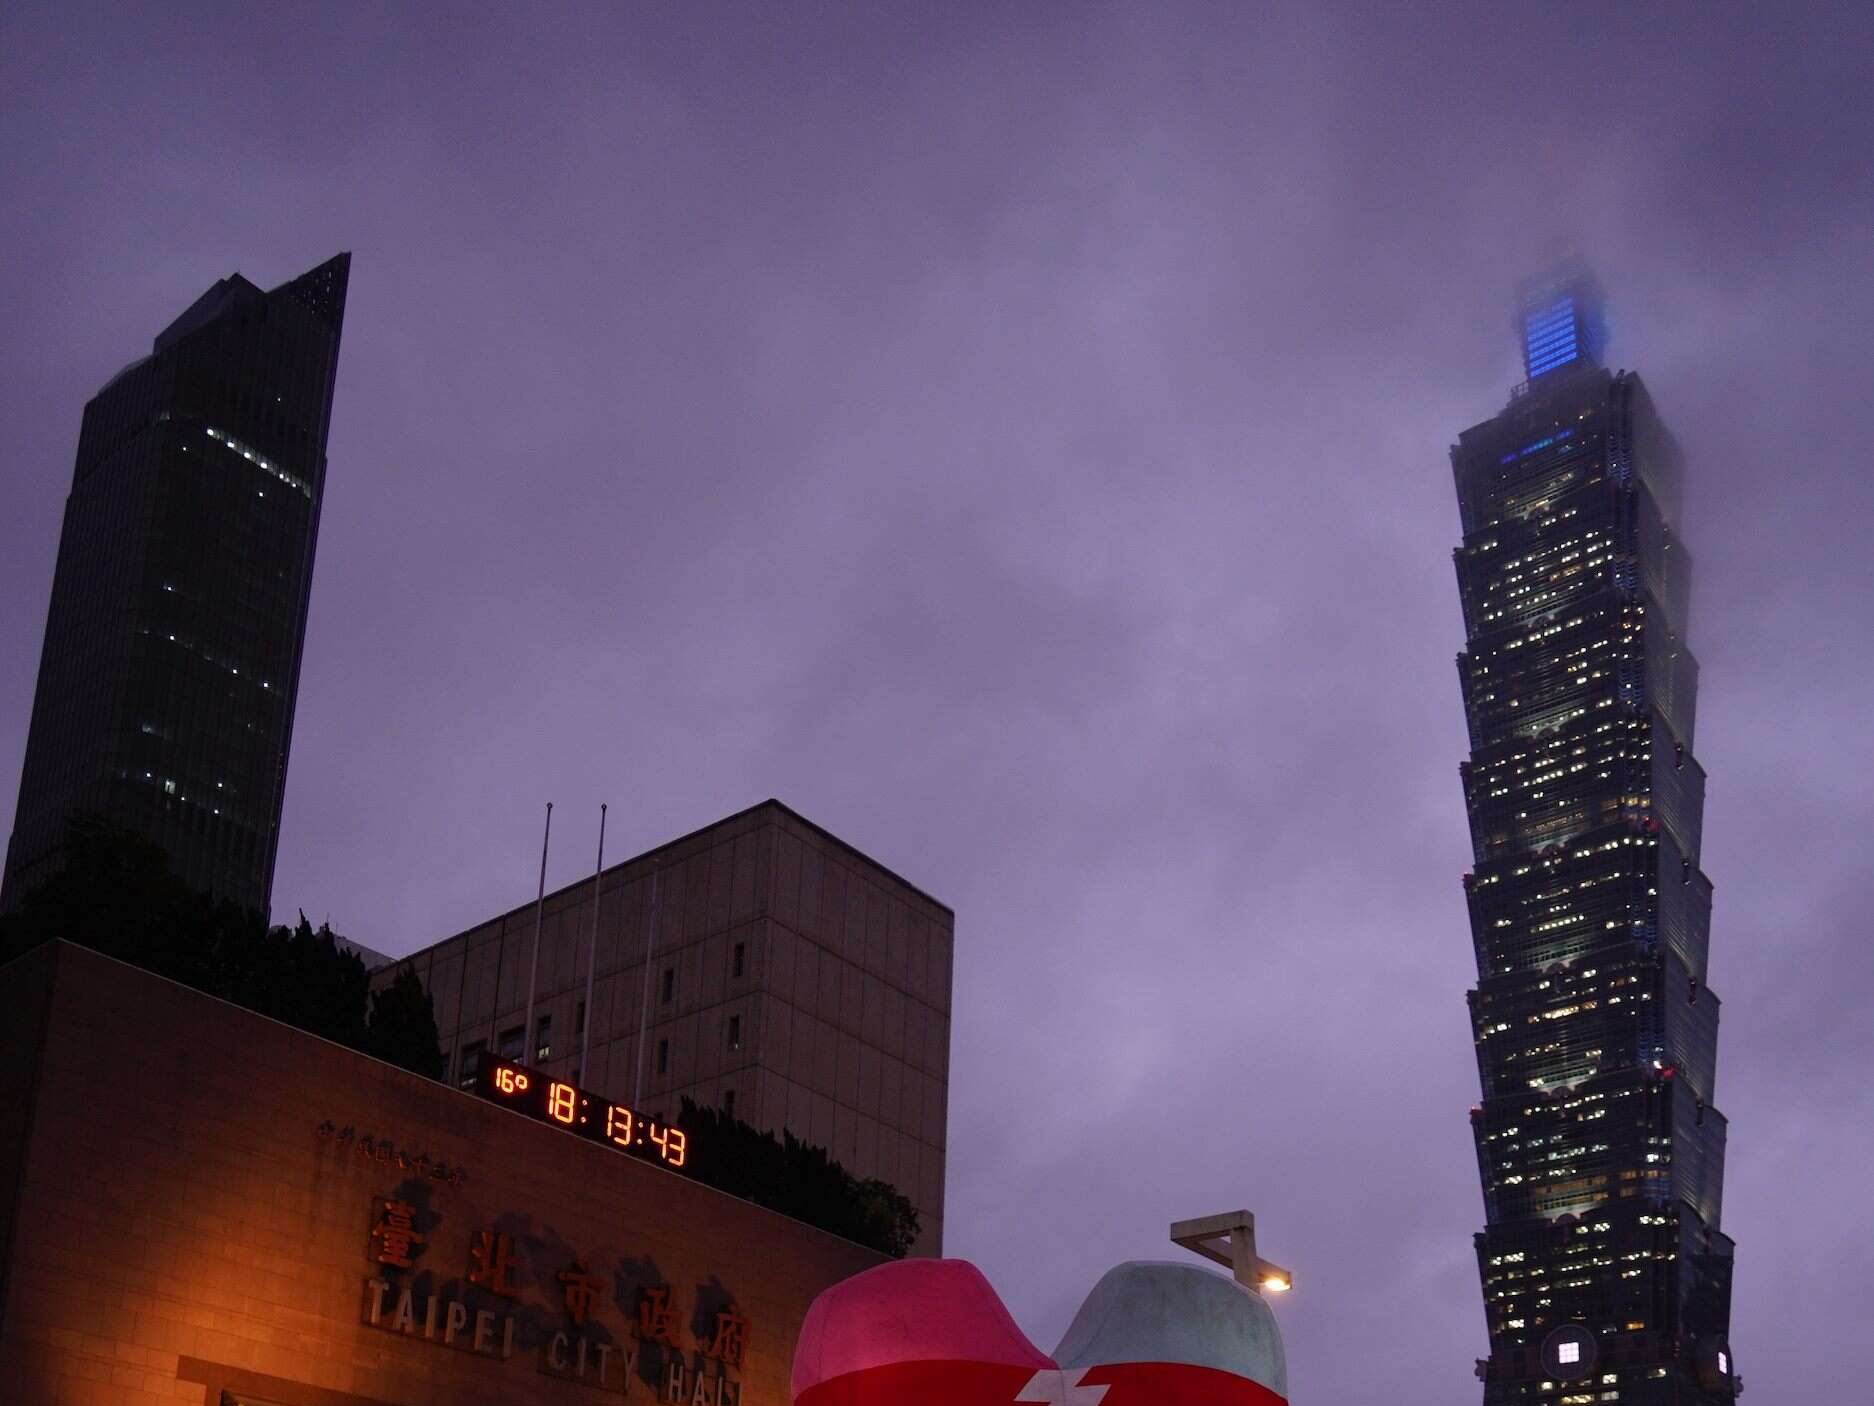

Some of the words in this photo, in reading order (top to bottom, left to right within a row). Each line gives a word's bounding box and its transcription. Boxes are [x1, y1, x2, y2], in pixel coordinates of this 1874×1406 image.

[367, 1277, 515, 1360] TAIPEI
[548, 1329, 639, 1393] CITY
[370, 1199, 750, 1372] 臺北市政府
